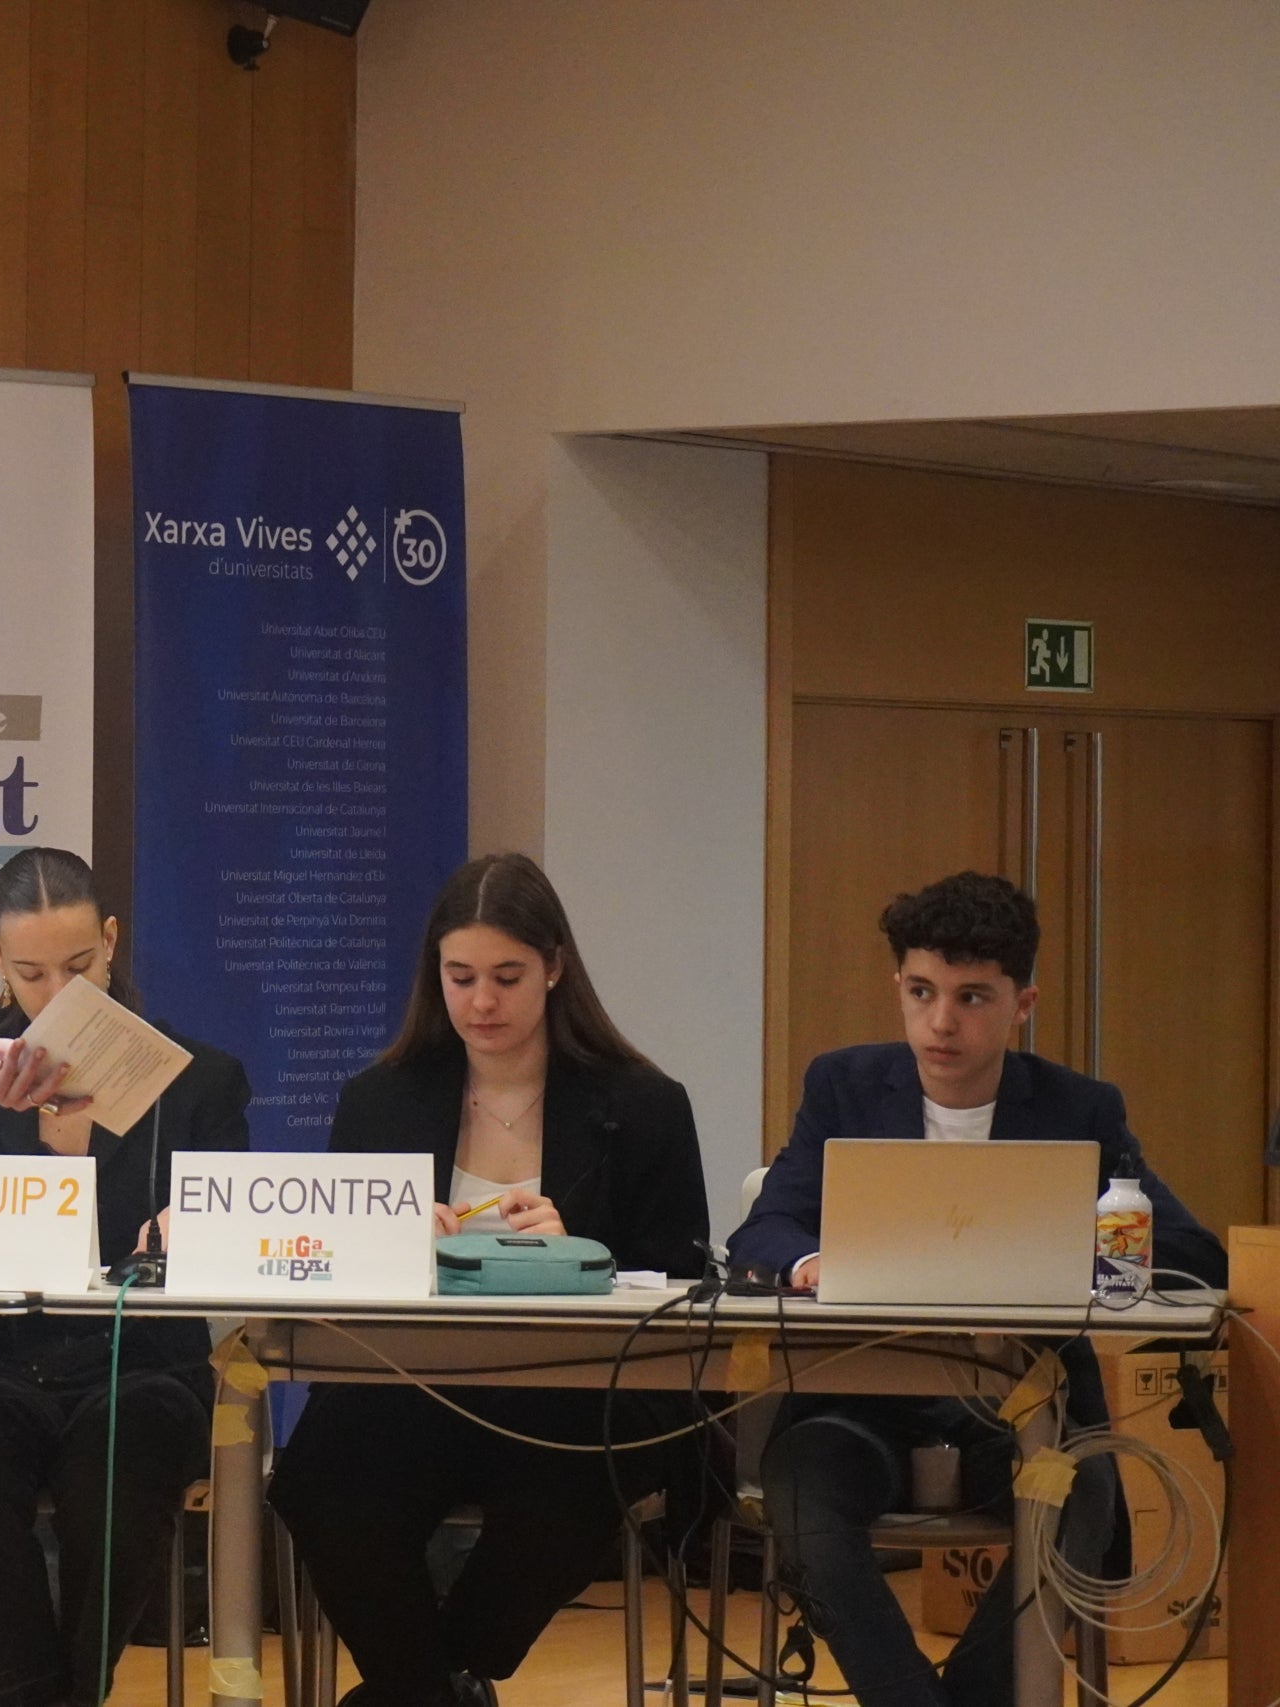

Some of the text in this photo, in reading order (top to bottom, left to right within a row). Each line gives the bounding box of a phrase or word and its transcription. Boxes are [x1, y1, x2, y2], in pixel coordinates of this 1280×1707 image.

[144, 511, 313, 552] Xarxa Vives
[402, 538, 437, 569] 30
[208, 557, 314, 581] d'universitats
[261, 623, 311, 637] Universitat
[290, 647, 342, 660] Universitat
[288, 669, 339, 682] Universitat
[218, 689, 269, 702] Universitat
[325, 693, 338, 705] de
[271, 712, 322, 726] Universitat
[325, 715, 338, 727] de
[230, 734, 281, 747] Universitat
[288, 758, 339, 771] Universitat
[342, 759, 354, 771] de
[249, 780, 300, 792] Universitat
[302, 781, 315, 793] de
[205, 802, 258, 814] Universitat
[325, 803, 338, 815] de
[295, 825, 347, 837] Universitat
[290, 848, 341, 860] Universitat
[345, 848, 357, 860] de
[221, 870, 271, 881] Universitat
[273, 870, 307, 884] Miguel
[236, 892, 286, 904] Universitat
[324, 892, 338, 904] de
[218, 914, 269, 927] Universitat
[271, 914, 284, 926] de
[216, 937, 266, 949] Universitat
[324, 936, 338, 948] de
[225, 959, 275, 972] Universitat
[333, 958, 345, 970] de
[261, 981, 313, 993] Universitat
[360, 980, 386, 993] Fabra
[275, 1003, 327, 1016] Universitat
[330, 1003, 365, 1015] Ramon
[269, 1026, 321, 1038] Universitat
[324, 1025, 354, 1037] Rovira
[288, 1048, 340, 1060] Universitat
[342, 1047, 355, 1059] de
[278, 1071, 330, 1083] Universitat
[332, 1070, 345, 1081] de
[299, 1093, 312, 1105] de
[313, 1092, 329, 1104] Vic
[287, 1115, 322, 1127] Central
[57, 1177, 80, 1216] 2
[180, 1176, 422, 1216] EN CONTRA
